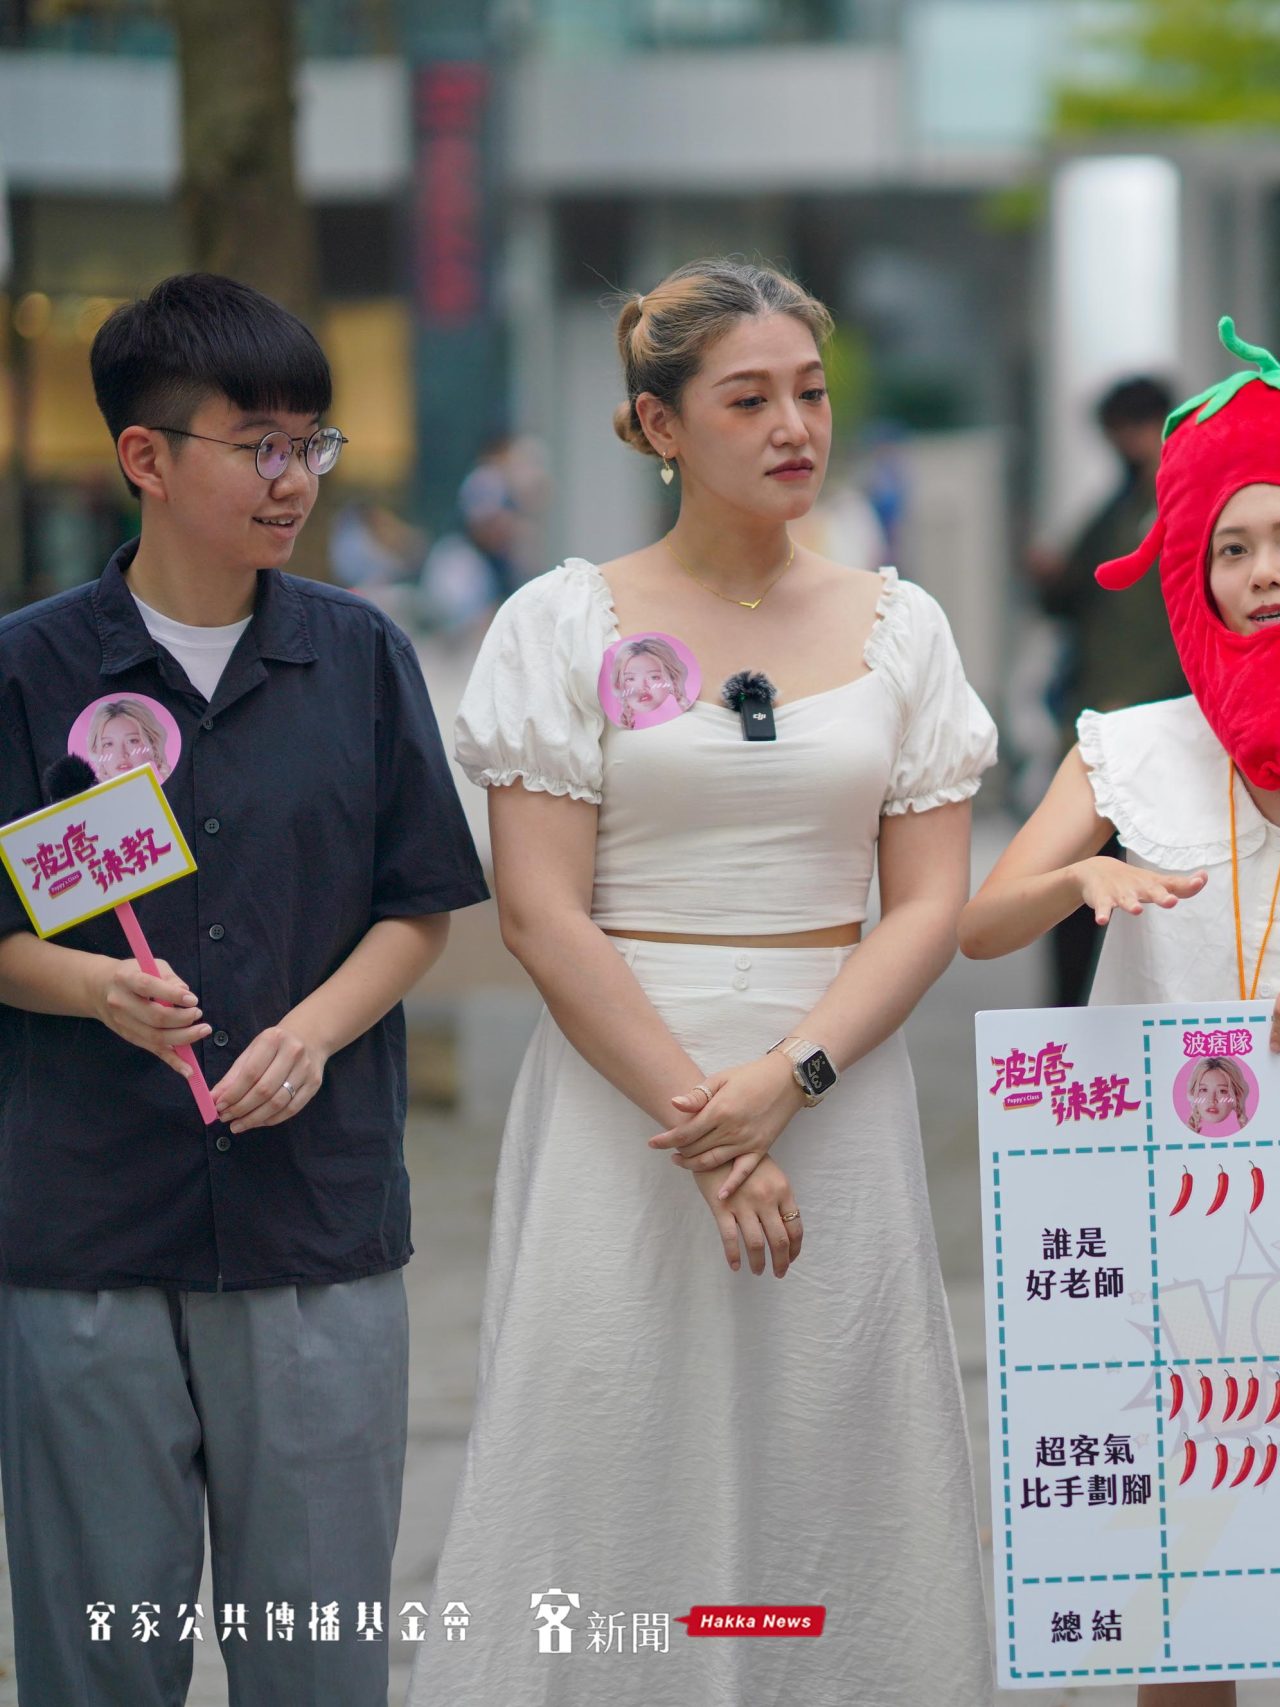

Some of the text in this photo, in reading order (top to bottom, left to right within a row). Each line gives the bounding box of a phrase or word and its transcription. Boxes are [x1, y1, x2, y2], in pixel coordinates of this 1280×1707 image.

[1184, 1031, 1252, 1055] 波痞隊
[1041, 1227, 1108, 1261] 誰是
[1025, 1267, 1125, 1302] 好老師
[1034, 1433, 1136, 1468] 超客氣
[1020, 1474, 1153, 1509] 比手劃腳
[1051, 1609, 1124, 1644] 總結
